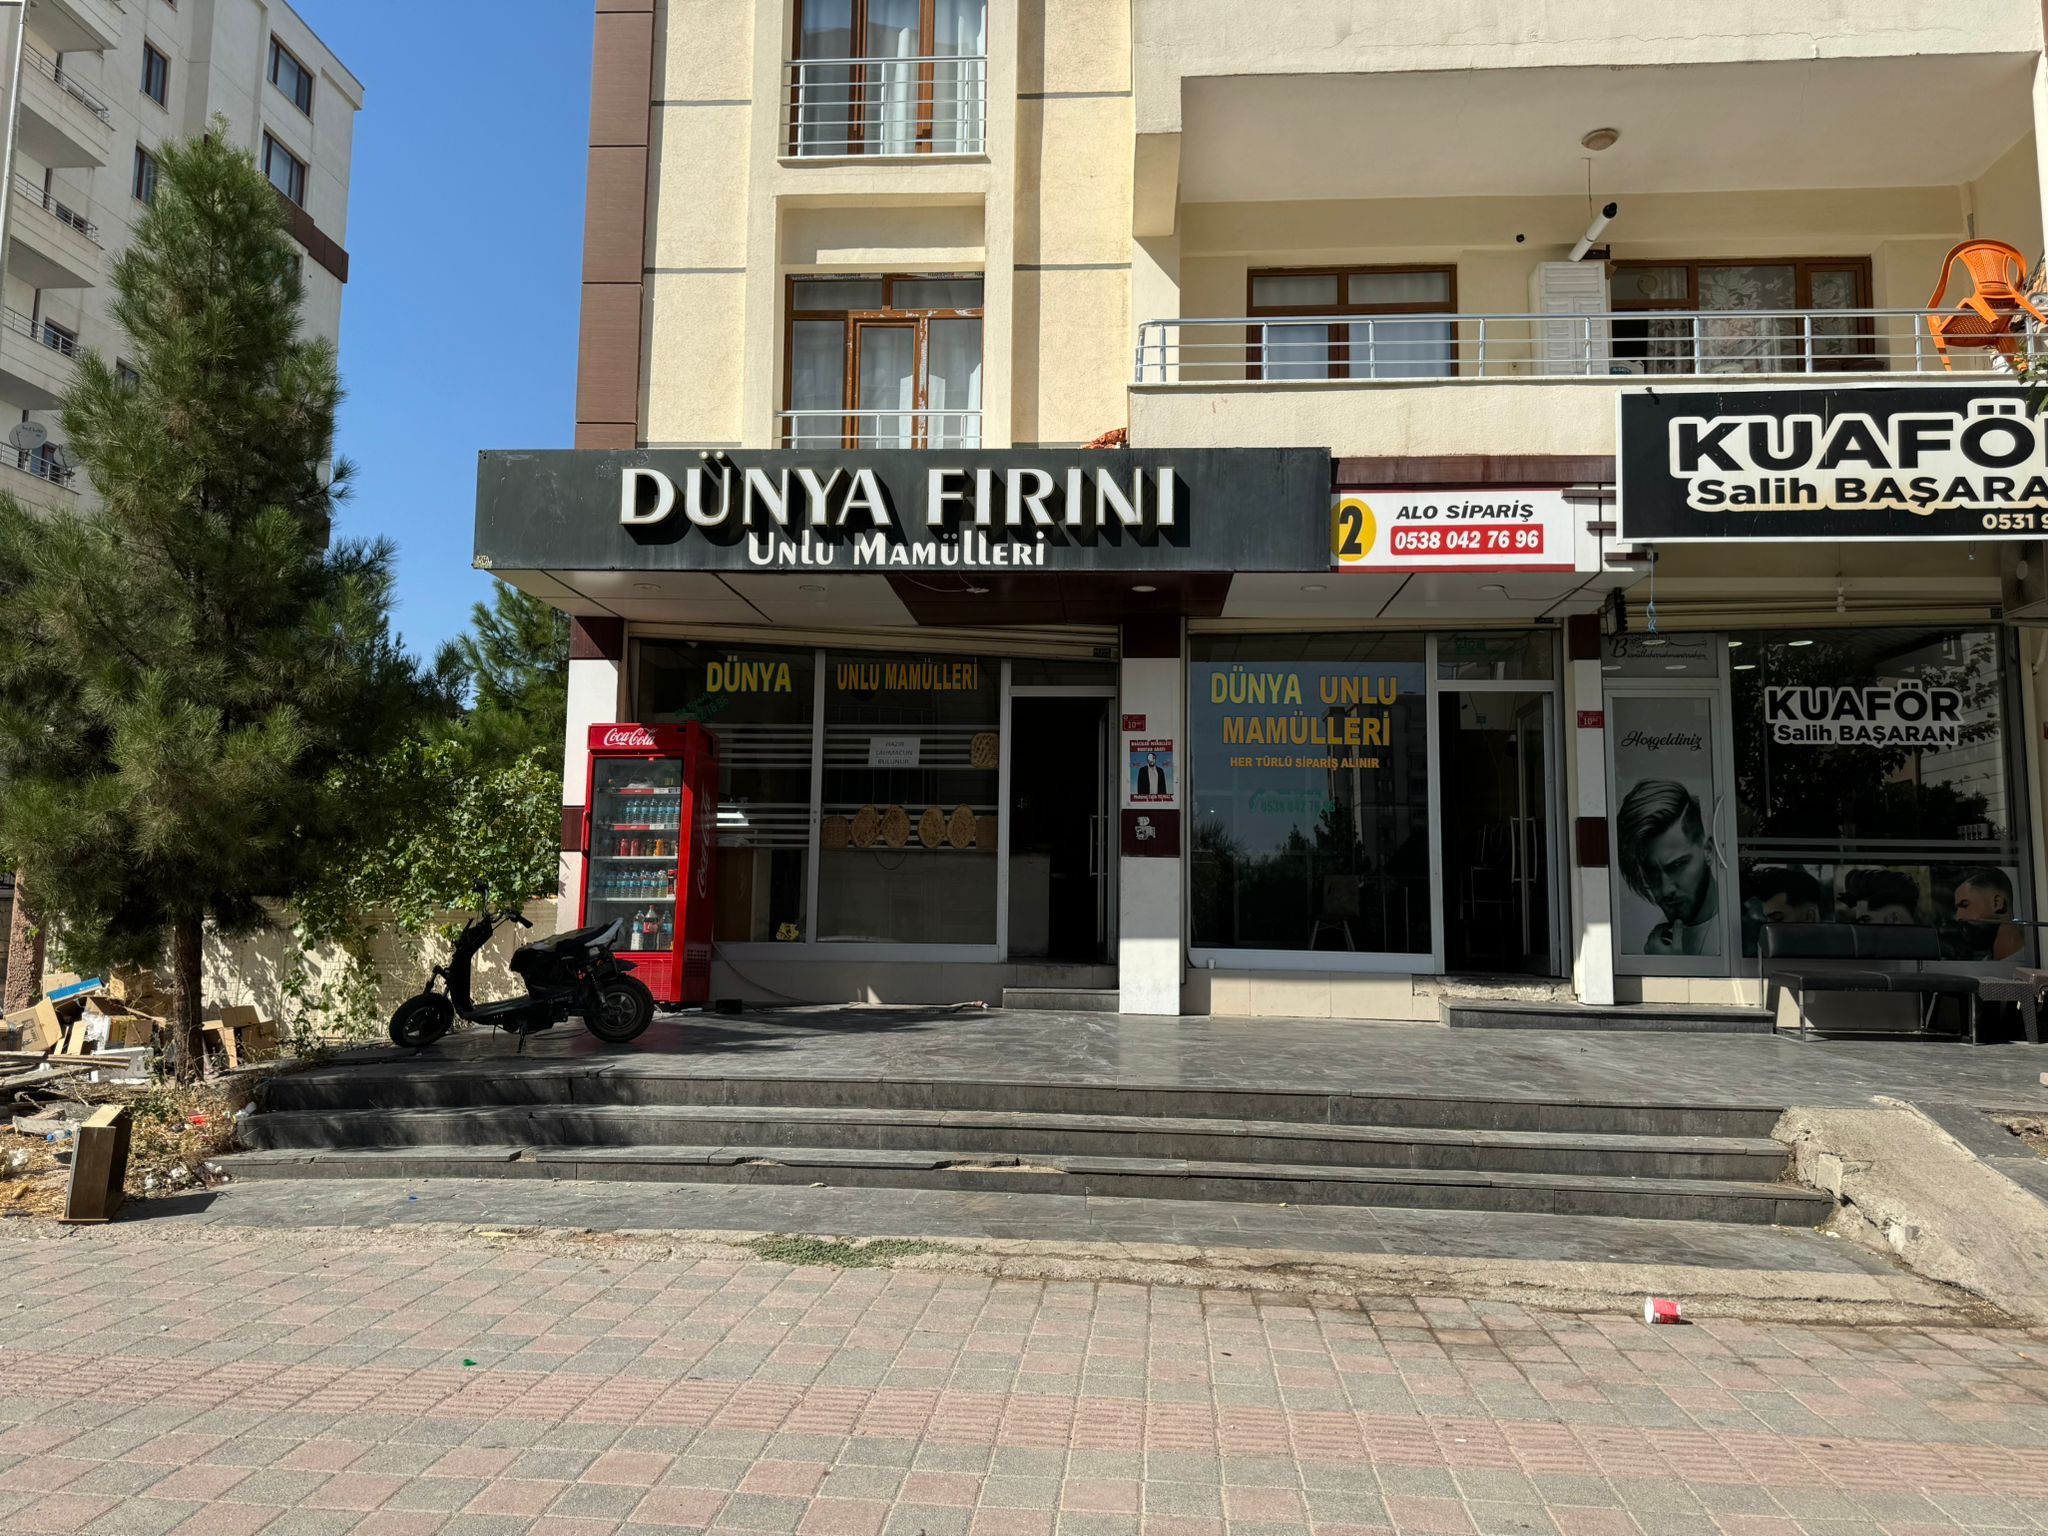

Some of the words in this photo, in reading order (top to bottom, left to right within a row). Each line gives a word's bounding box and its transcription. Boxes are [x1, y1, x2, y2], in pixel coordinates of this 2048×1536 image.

[1675, 402, 2048, 472] KUAFÖ
[619, 450, 892, 526] DÜNYA
[926, 466, 1175, 526] FIRINI
[1697, 479, 1817, 505] Salih
[1396, 504, 1438, 520] ALO
[1445, 500, 1534, 522] SİPARİŞ
[1982, 513, 2034, 530] 0531
[1338, 505, 1363, 555] 2
[1394, 531, 1441, 550] 0538
[1446, 530, 1481, 550] 042
[1487, 530, 1510, 549] 76
[1515, 530, 1539, 549] 96
[706, 655, 792, 692] DÜNYA
[836, 663, 880, 690] UNLU
[885, 657, 979, 690] MAMÜLLERİ
[1210, 665, 1302, 705] DÜNYA
[1319, 675, 1397, 705] UNLU
[1767, 681, 1962, 722] KUAFÖR
[1222, 710, 1391, 746] MAMÜLLERİ
[1777, 724, 1832, 743] Salih
[1839, 724, 1955, 746] BAŞARAN
[1230, 757, 1253, 767] HER
[1256, 755, 1292, 768] TÜRLÜ
[1296, 755, 1338, 770] SİPARİŞ
[1341, 758, 1379, 768] ALINIR
